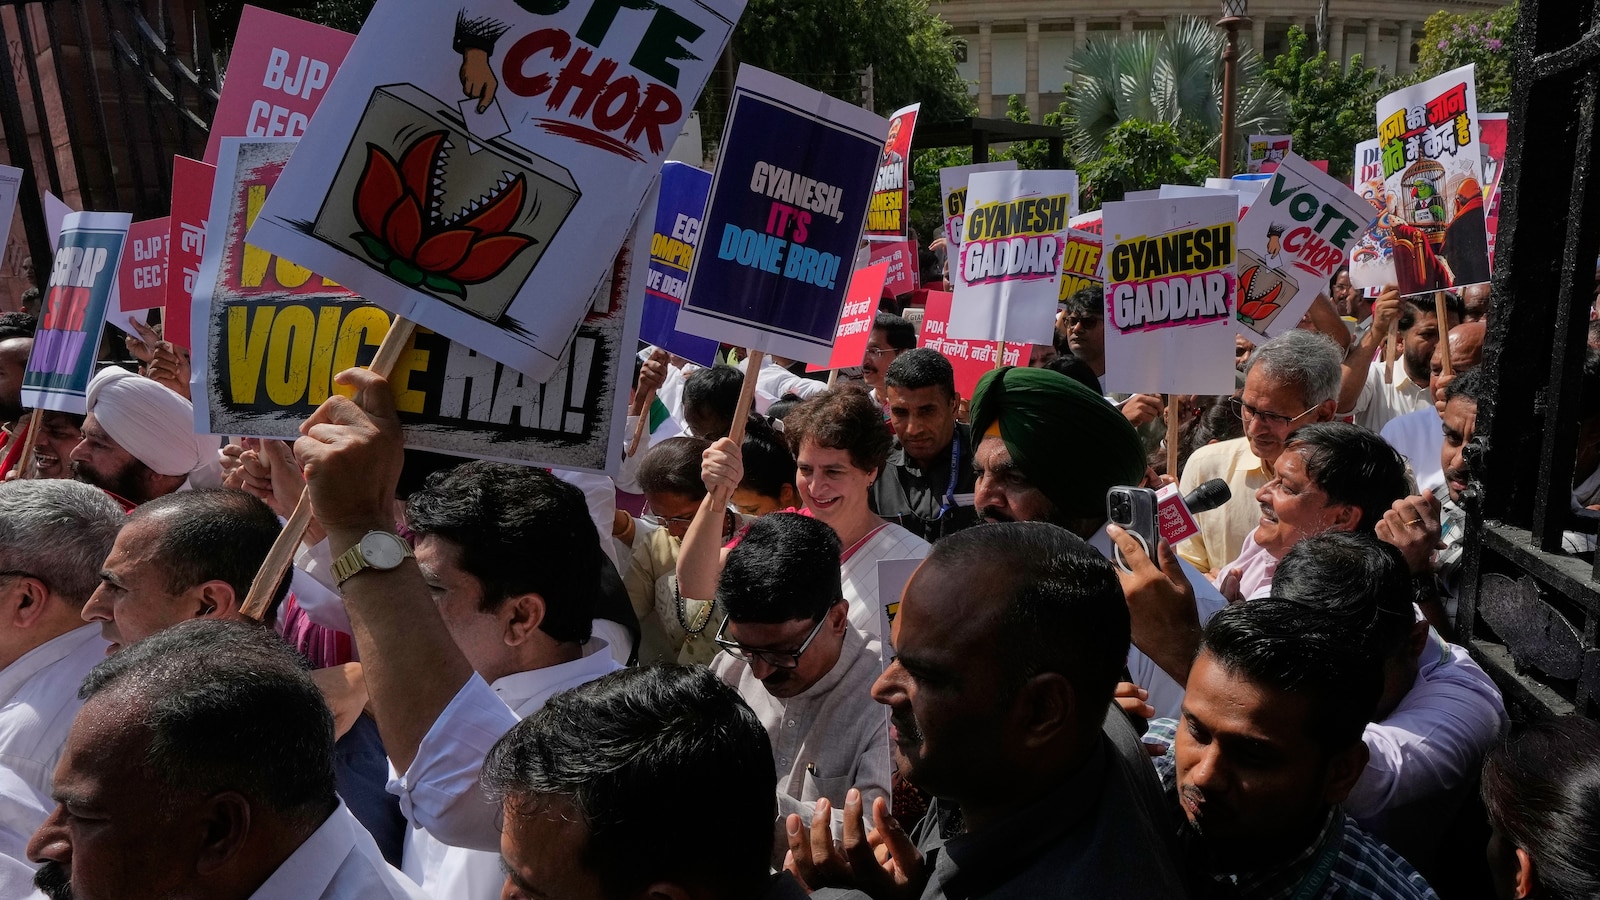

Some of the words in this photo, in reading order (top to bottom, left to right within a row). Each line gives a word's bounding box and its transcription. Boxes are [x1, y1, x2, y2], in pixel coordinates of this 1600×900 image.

[262, 47, 330, 100] BJP
[502, 28, 683, 155] CHOR
[1378, 108, 1407, 150] राजा
[1406, 105, 1426, 130] की
[1425, 81, 1467, 124] जान
[1405, 134, 1420, 162] में
[1422, 119, 1458, 160] कैद
[1456, 113, 1471, 147] है
[750, 160, 845, 224] GYANESH,
[874, 162, 903, 192] SIGN
[765, 201, 812, 244] IT'S
[869, 191, 903, 212] ANESH
[968, 196, 1066, 241] GYANESH
[1269, 172, 1357, 248] VOTE
[50, 247, 108, 288] SCRAP
[133, 236, 162, 262] BJP
[718, 223, 787, 275] DONE
[783, 242, 842, 290] BRO!
[964, 236, 1059, 283] GADDAR
[1111, 225, 1231, 282] GYANESH
[1282, 225, 1344, 277] CHOR
[133, 264, 162, 290] CEC
[1112, 272, 1229, 331] GADDAR
[925, 320, 944, 335] PDA
[943, 340, 969, 360] चलेगी,
[971, 345, 993, 362] नहीं
[29, 329, 87, 375] NOW
[227, 305, 435, 415] VOICE
[439, 336, 597, 435] HAI!
